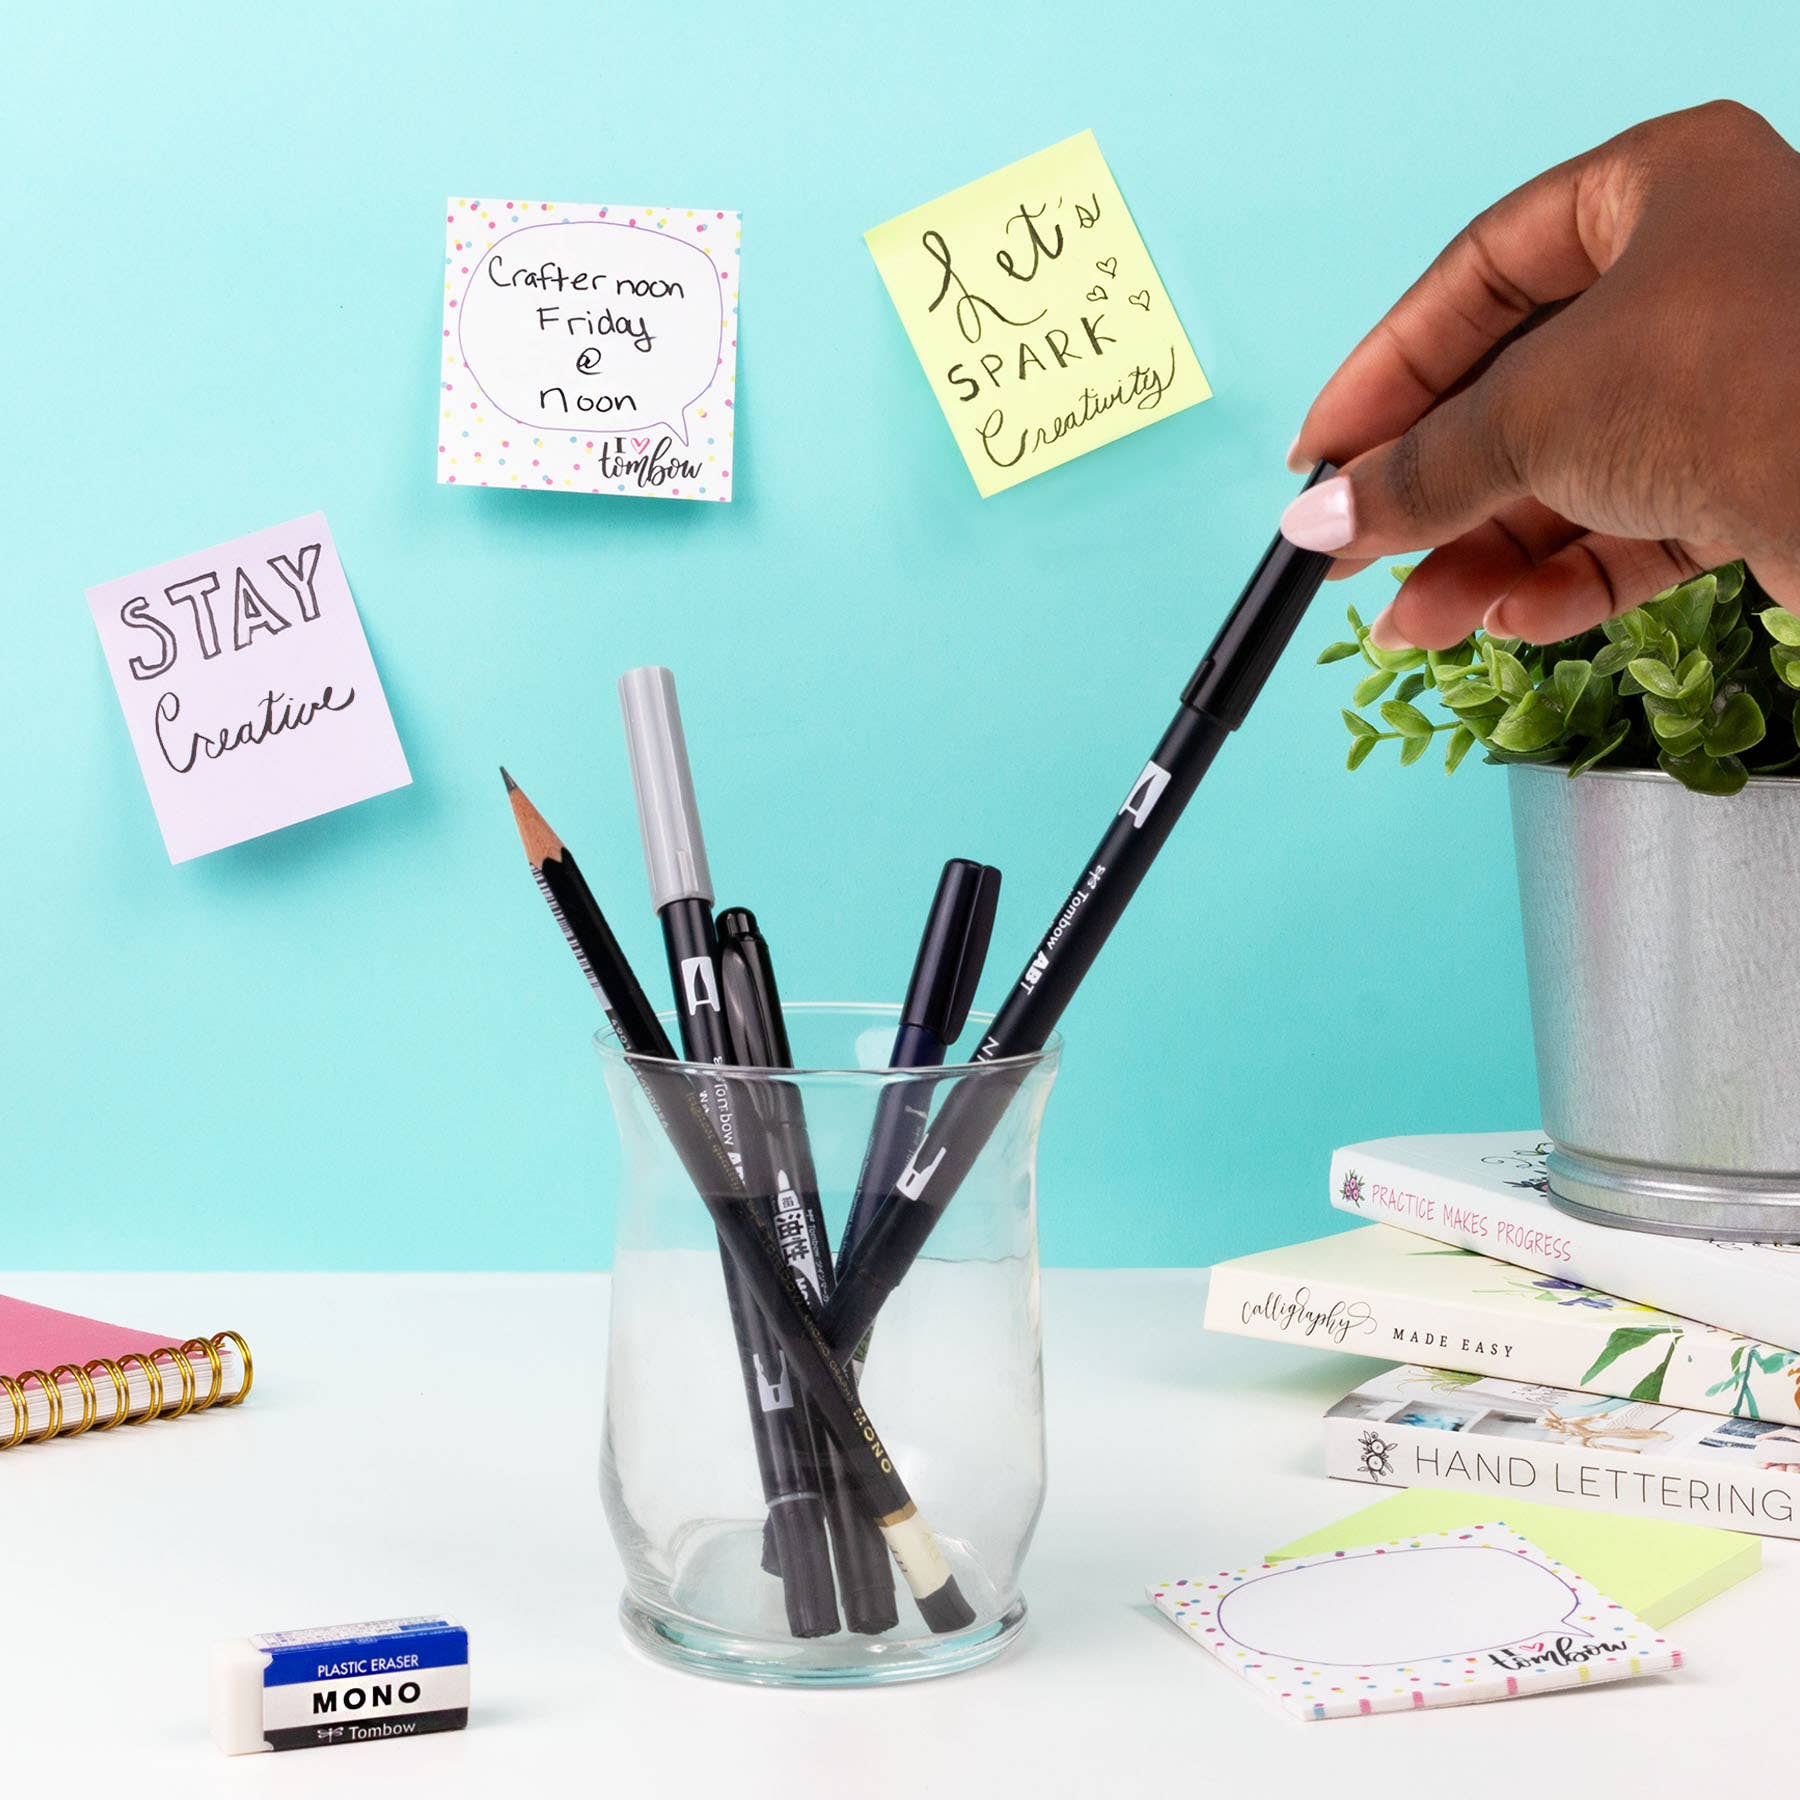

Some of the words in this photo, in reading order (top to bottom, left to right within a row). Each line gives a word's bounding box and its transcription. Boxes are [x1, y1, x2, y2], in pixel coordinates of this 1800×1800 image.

[922, 192, 1101, 343] Let's
[537, 306, 656, 352] Friday
[947, 314, 1117, 402] SPARK
[576, 347, 603, 375] @
[975, 345, 1176, 467] Creativity
[598, 437, 702, 488] tombow
[120, 543, 321, 680] STAY
[155, 686, 355, 773] Creative
[1047, 890, 1090, 951] Tombow
[1020, 950, 1050, 996] ABT
[807, 1223, 820, 1257] Tombow
[1372, 1184, 1435, 1221] PRACTICE
[1443, 1204, 1489, 1239] MAKES
[1497, 1220, 1574, 1263] PROGRESS
[1241, 1286, 1378, 1344] calligraphy
[1393, 1327, 1449, 1348] MADE
[1461, 1338, 1515, 1359] EASY
[853, 1407, 892, 1474] MONO
[1415, 1445, 1536, 1488] HAND
[1555, 1463, 1796, 1522] LETTERING
[318, 1660, 367, 1678] PLASTIC
[371, 1655, 419, 1672] ERASER
[1487, 1636, 1628, 1671] tombow
[312, 1681, 421, 1714] MONO
[349, 1722, 416, 1740] Tombow
